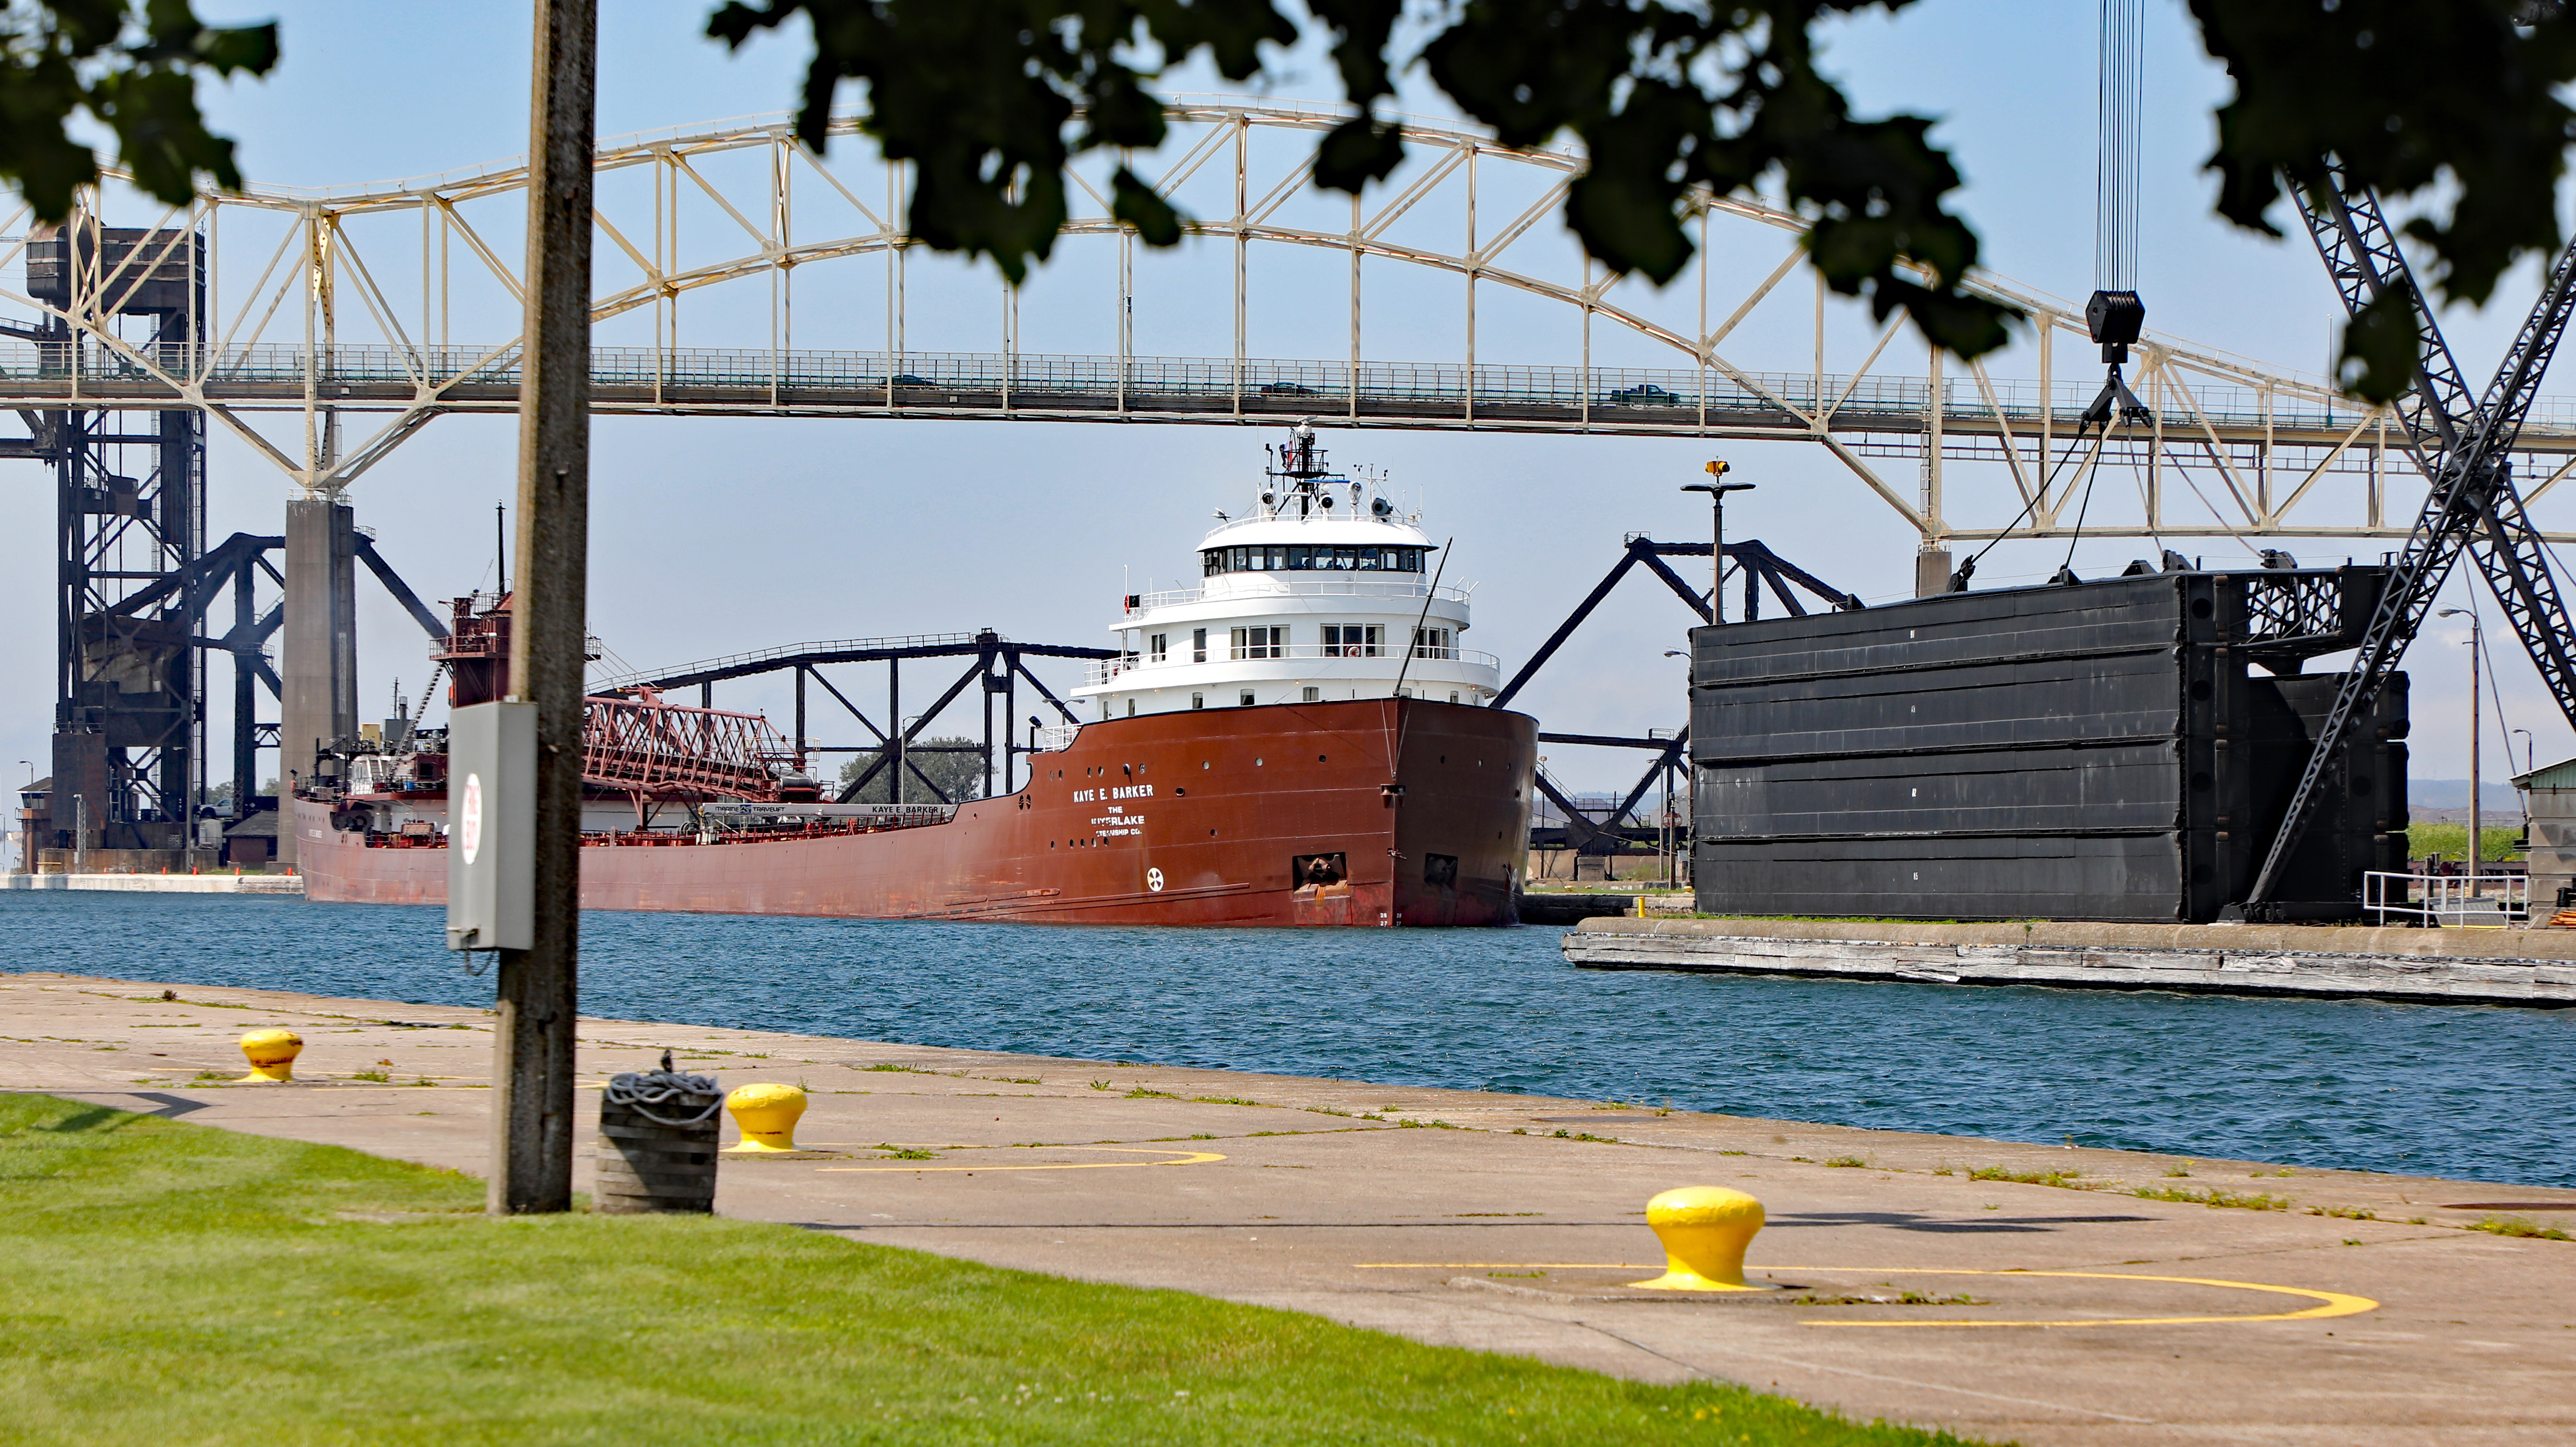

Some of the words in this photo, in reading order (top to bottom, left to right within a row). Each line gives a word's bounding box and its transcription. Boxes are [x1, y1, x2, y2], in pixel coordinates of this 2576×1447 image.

[1074, 789, 1095, 803] KAYE
[1099, 788, 1108, 800] E.
[1112, 784, 1154, 799] BARKER
[1108, 806, 1123, 814] THE
